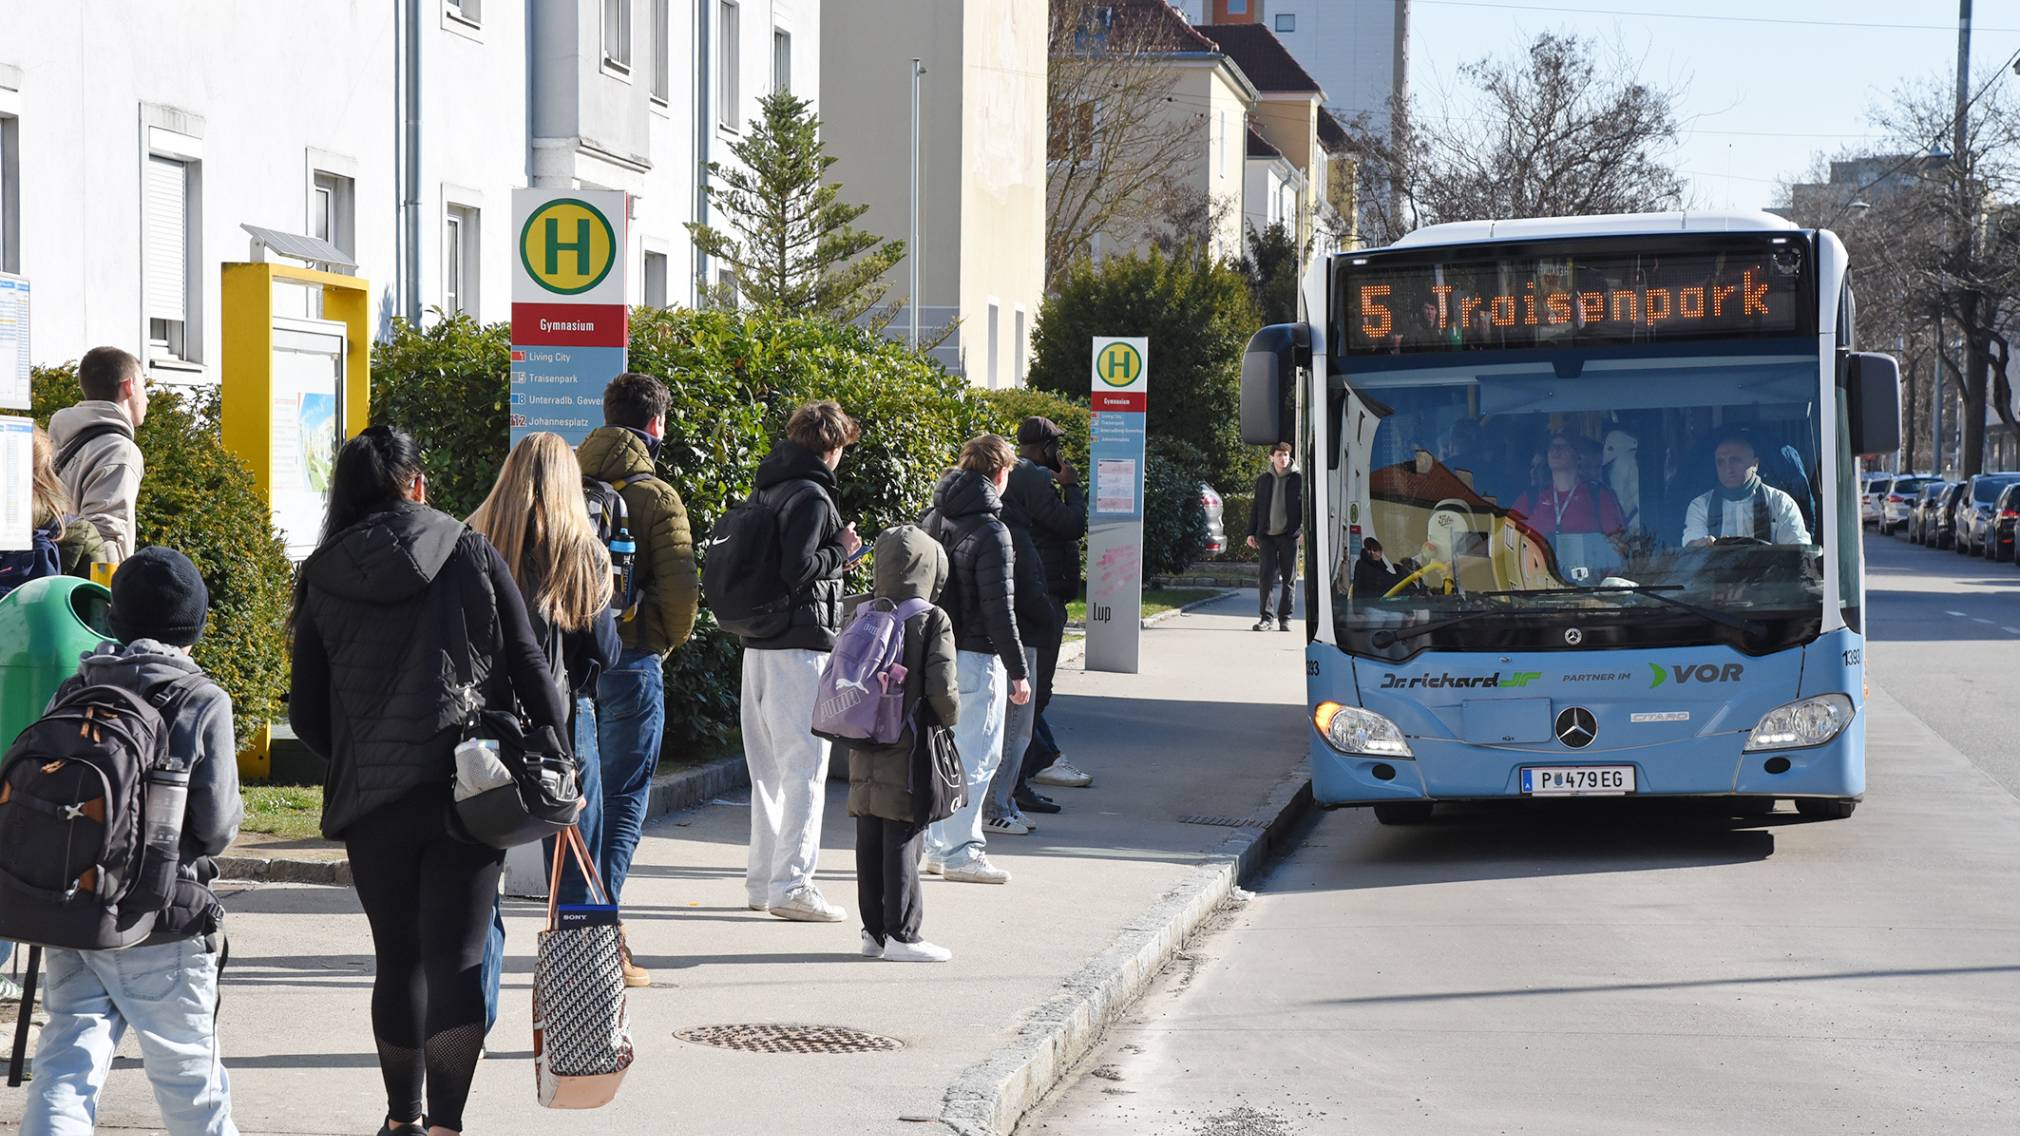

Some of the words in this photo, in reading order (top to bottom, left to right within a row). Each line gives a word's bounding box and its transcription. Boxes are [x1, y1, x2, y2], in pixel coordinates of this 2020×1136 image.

[545, 218, 590, 275] H
[1360, 284, 1391, 338] 5
[1432, 270, 1769, 328] Traisenpark
[540, 319, 594, 333] Gymnasium
[529, 352, 553, 363] Living
[555, 352, 571, 363] City
[1108, 351, 1130, 378] H
[529, 374, 578, 384] Traisenpark
[529, 416, 589, 428] Johannesplatz
[1093, 602, 1111, 622] Lup
[1842, 649, 1860, 666] 1393
[1562, 673, 1615, 682] PARTNER
[1617, 672, 1631, 681] IM
[1672, 663, 1744, 684] VOR
[1542, 772, 1552, 788] P
